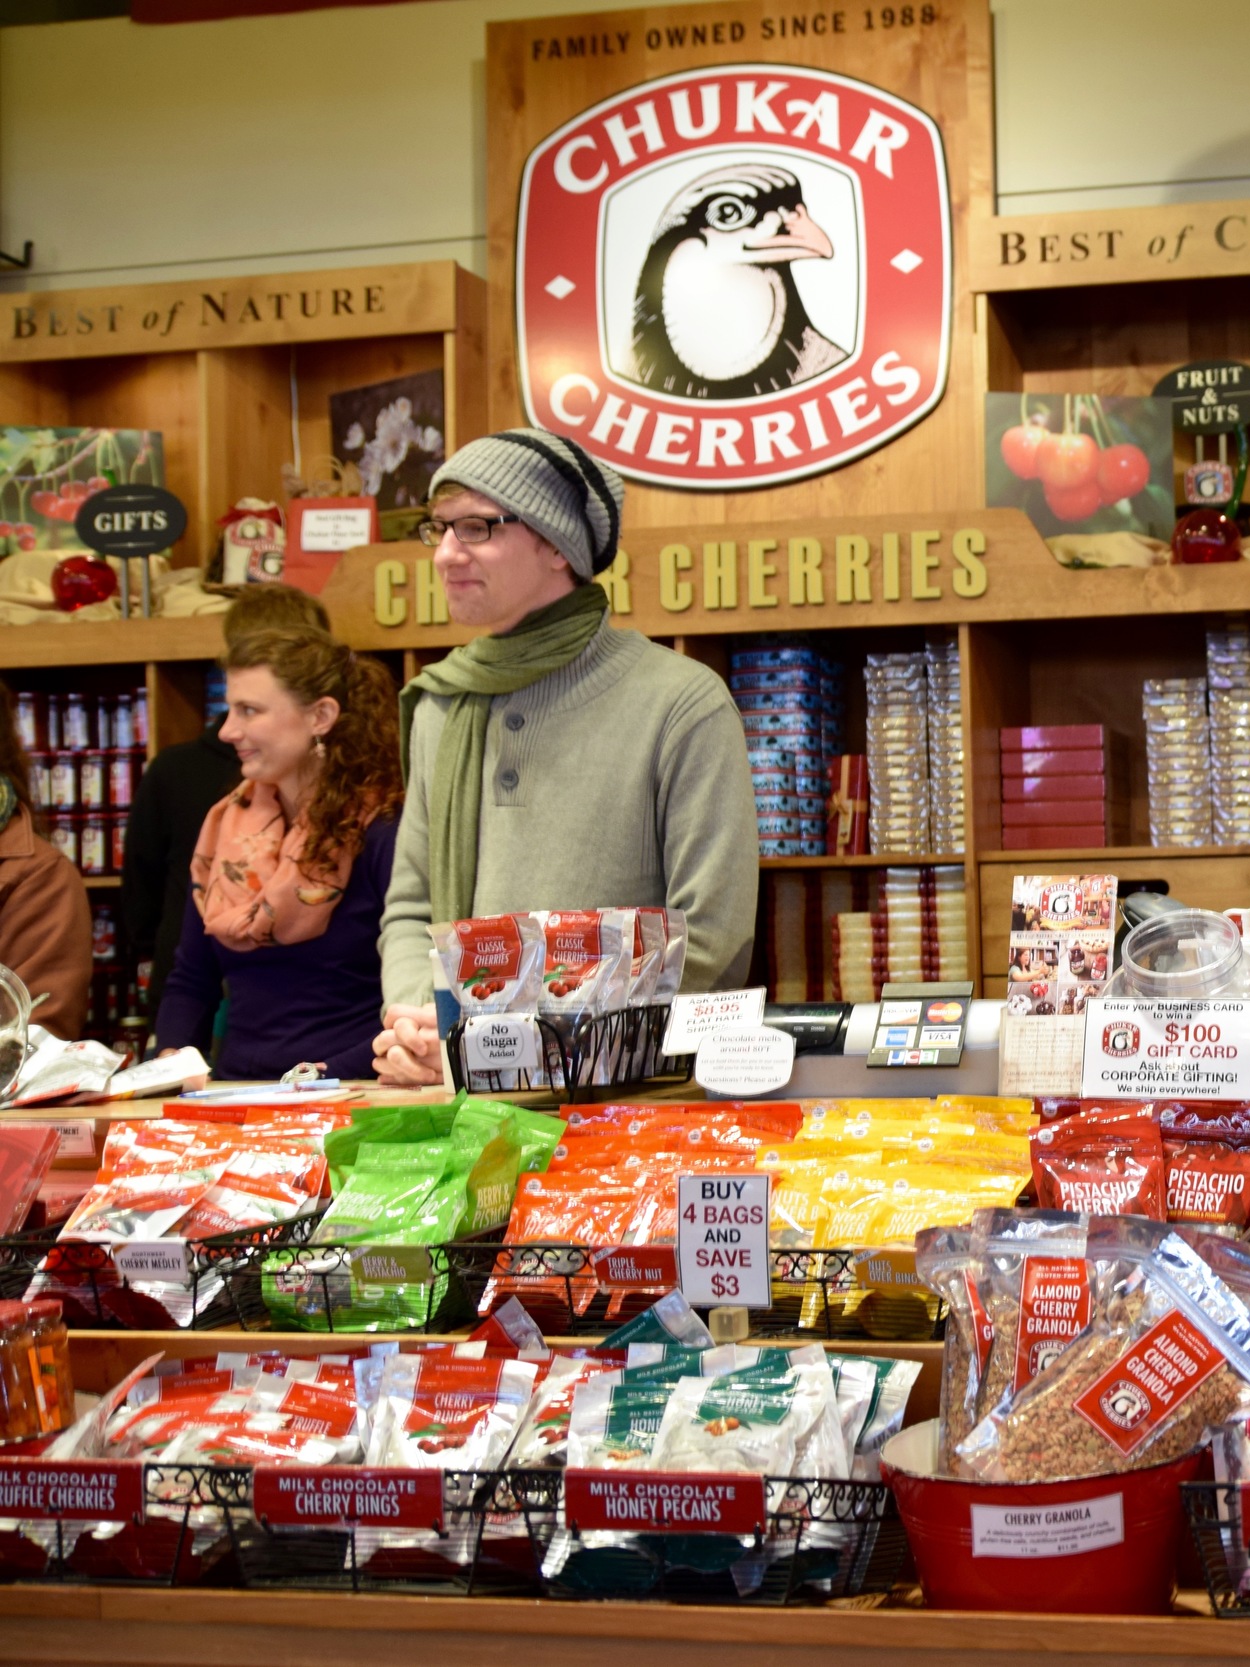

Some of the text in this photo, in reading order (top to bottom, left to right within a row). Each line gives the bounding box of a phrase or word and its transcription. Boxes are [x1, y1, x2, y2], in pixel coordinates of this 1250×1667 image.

[532, 3, 937, 62] FAMILY OWNED SINCE 1988
[553, 80, 909, 194] CHUKAR
[12, 285, 385, 339] BEST of NATURE
[1177, 366, 1243, 389] FRUIT
[1201, 387, 1217, 405] &
[549, 351, 921, 467] CHERRIES
[1183, 404, 1239, 426] NUTS
[94, 511, 168, 532] GIFTS
[374, 528, 988, 627] CHR CHERRIES
[476, 941, 507, 953] CLASSIC
[556, 937, 584, 949] CLASSIC
[474, 953, 509, 966] CHERRIES
[552, 951, 588, 963] CHERRIES
[1103, 1002, 1243, 1012] Enter your BUSINESS CARD
[491, 1024, 508, 1035] No
[1165, 1023, 1221, 1044] $100
[483, 1035, 518, 1049] Sugar
[489, 1050, 515, 1058] Added
[1147, 1045, 1238, 1059] GIFT CARD
[1139, 1061, 1199, 1072] Ask about
[1101, 1072, 1238, 1083] CORPORATE GIFTING!
[1117, 1084, 1220, 1095] We ship everywhere!
[1168, 1167, 1245, 1195] PISTACHIO
[701, 1181, 745, 1200] BUY
[1166, 1187, 1224, 1212] CHERRY
[682, 1204, 764, 1225] 4 BAGS
[705, 1229, 741, 1244] AND
[120, 1257, 181, 1271] CHERRY MEDLEY
[607, 1256, 635, 1268] TRIPLE
[695, 1248, 752, 1269] SAVE
[867, 1260, 892, 1272] NUTS
[608, 1267, 662, 1281] CHERRY NUT
[711, 1272, 740, 1297] $3
[1031, 1285, 1081, 1299] ALMOND
[1033, 1301, 1078, 1319] CHERRY
[1027, 1317, 1081, 1335] GRANOLA
[1153, 1334, 1198, 1377] ALMOND
[1143, 1348, 1186, 1387] CHERRY
[1126, 1355, 1175, 1406] GRANOLA
[27, 1472, 117, 1488] CHOCOLATE
[279, 1477, 416, 1494] MILK CHOCOLATE
[49, 1487, 115, 1511] CHERRIES
[589, 1482, 736, 1500] MILK CHOCOLATE
[295, 1494, 400, 1516] CHERRY BINGS
[605, 1497, 721, 1522] HONEY PECANS
[1004, 1507, 1091, 1526] CHERRY GRANOLA
